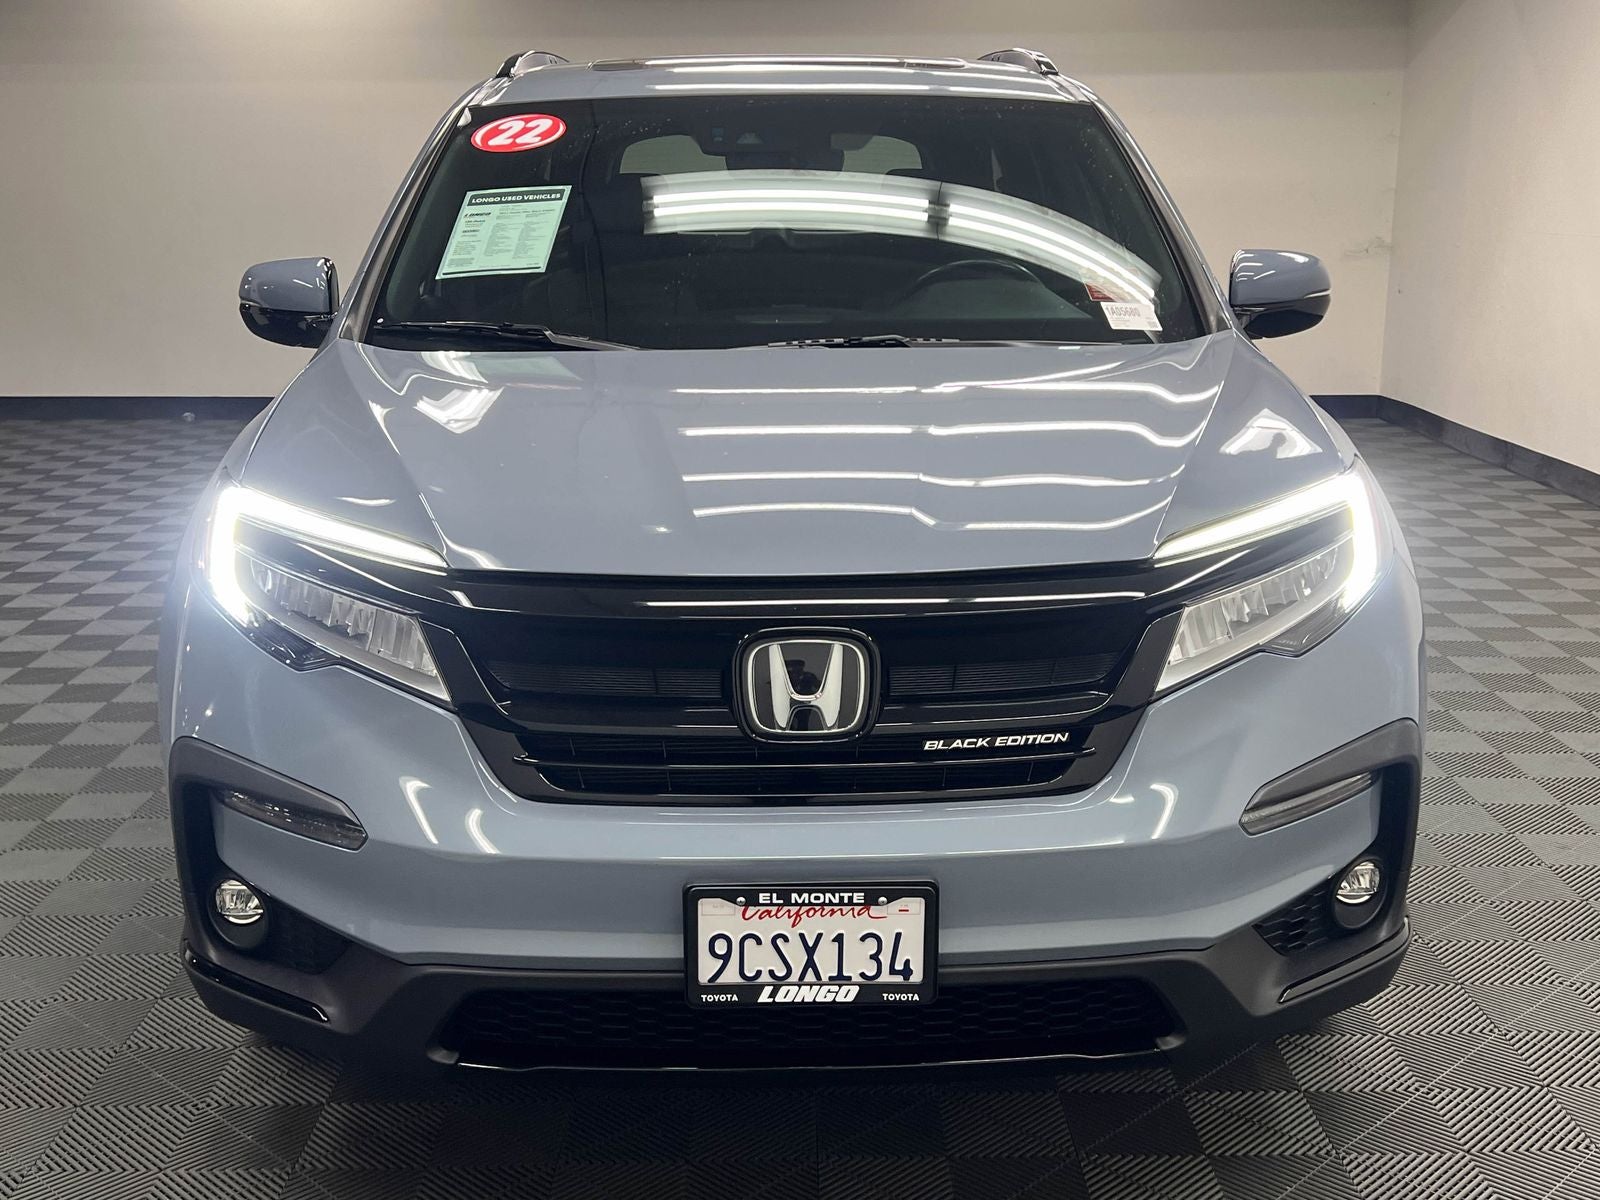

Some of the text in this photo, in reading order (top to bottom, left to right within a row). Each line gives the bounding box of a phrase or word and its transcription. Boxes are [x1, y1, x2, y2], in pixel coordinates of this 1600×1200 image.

[487, 118, 553, 146] 22
[472, 195, 500, 204] LONGO
[524, 193, 560, 201] VEHICLES
[923, 732, 1069, 751] BLACK EDITION
[758, 892, 865, 904] EL MONTE
[707, 931, 914, 984] 9CSX134
[700, 993, 739, 1003] TOYOTA
[757, 985, 860, 1003] LONGO
[882, 993, 920, 1002] TOYOTA
